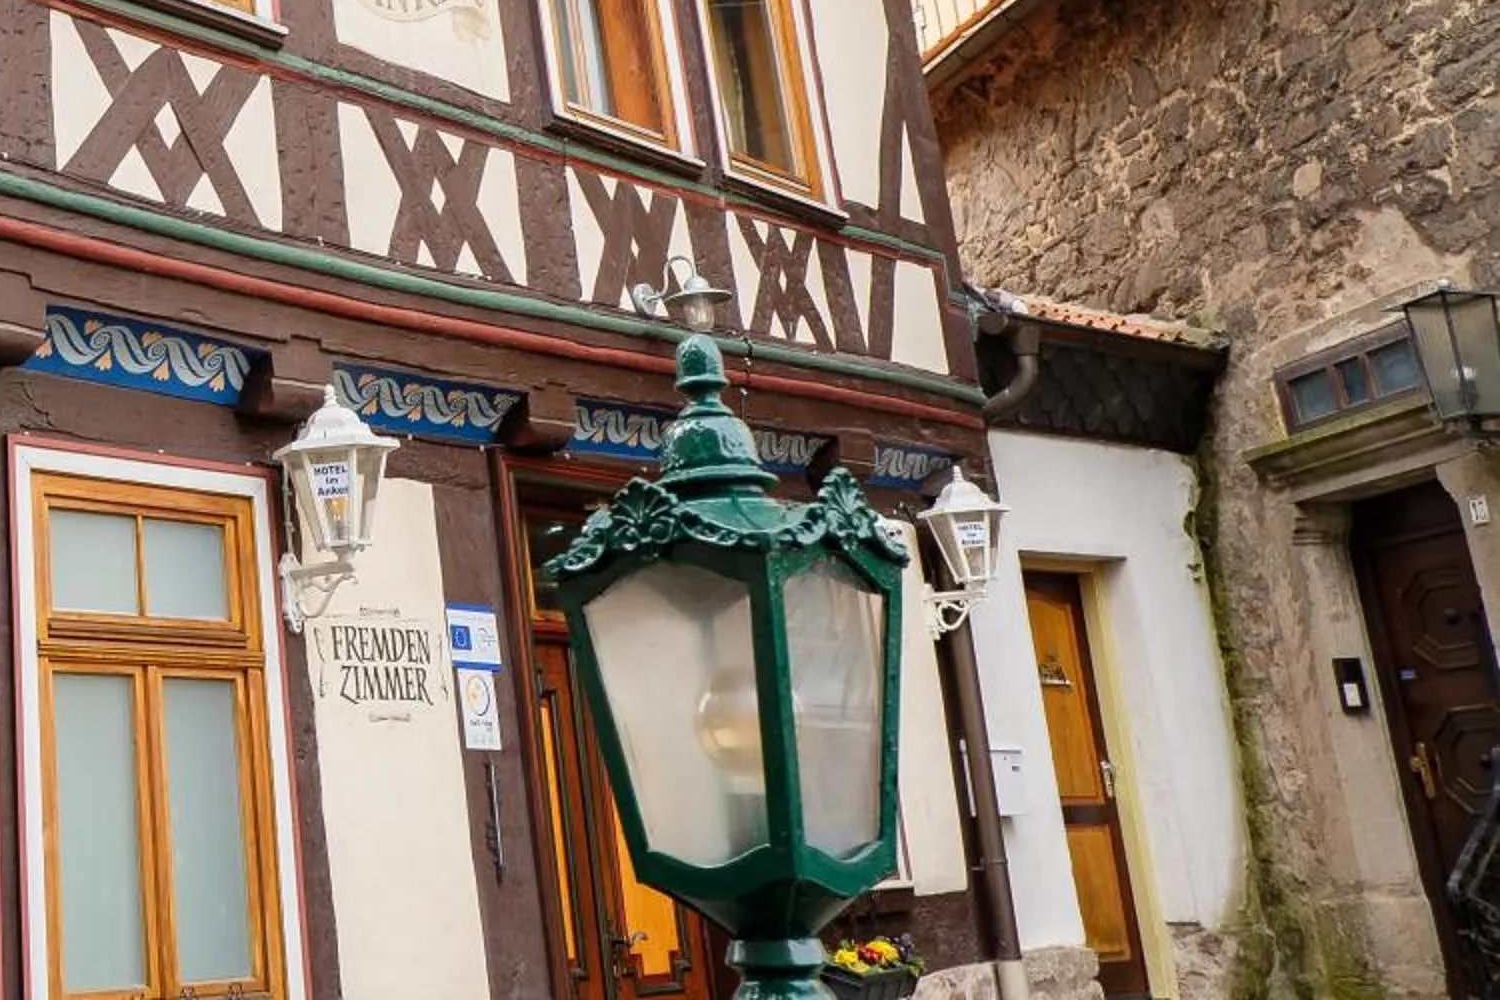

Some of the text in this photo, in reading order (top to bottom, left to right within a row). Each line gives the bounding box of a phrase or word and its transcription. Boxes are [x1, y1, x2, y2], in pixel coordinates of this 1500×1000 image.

[314, 465, 348, 476] HOTEL
[330, 624, 431, 664] FREMDEN
[340, 665, 433, 706] ZIMMER
